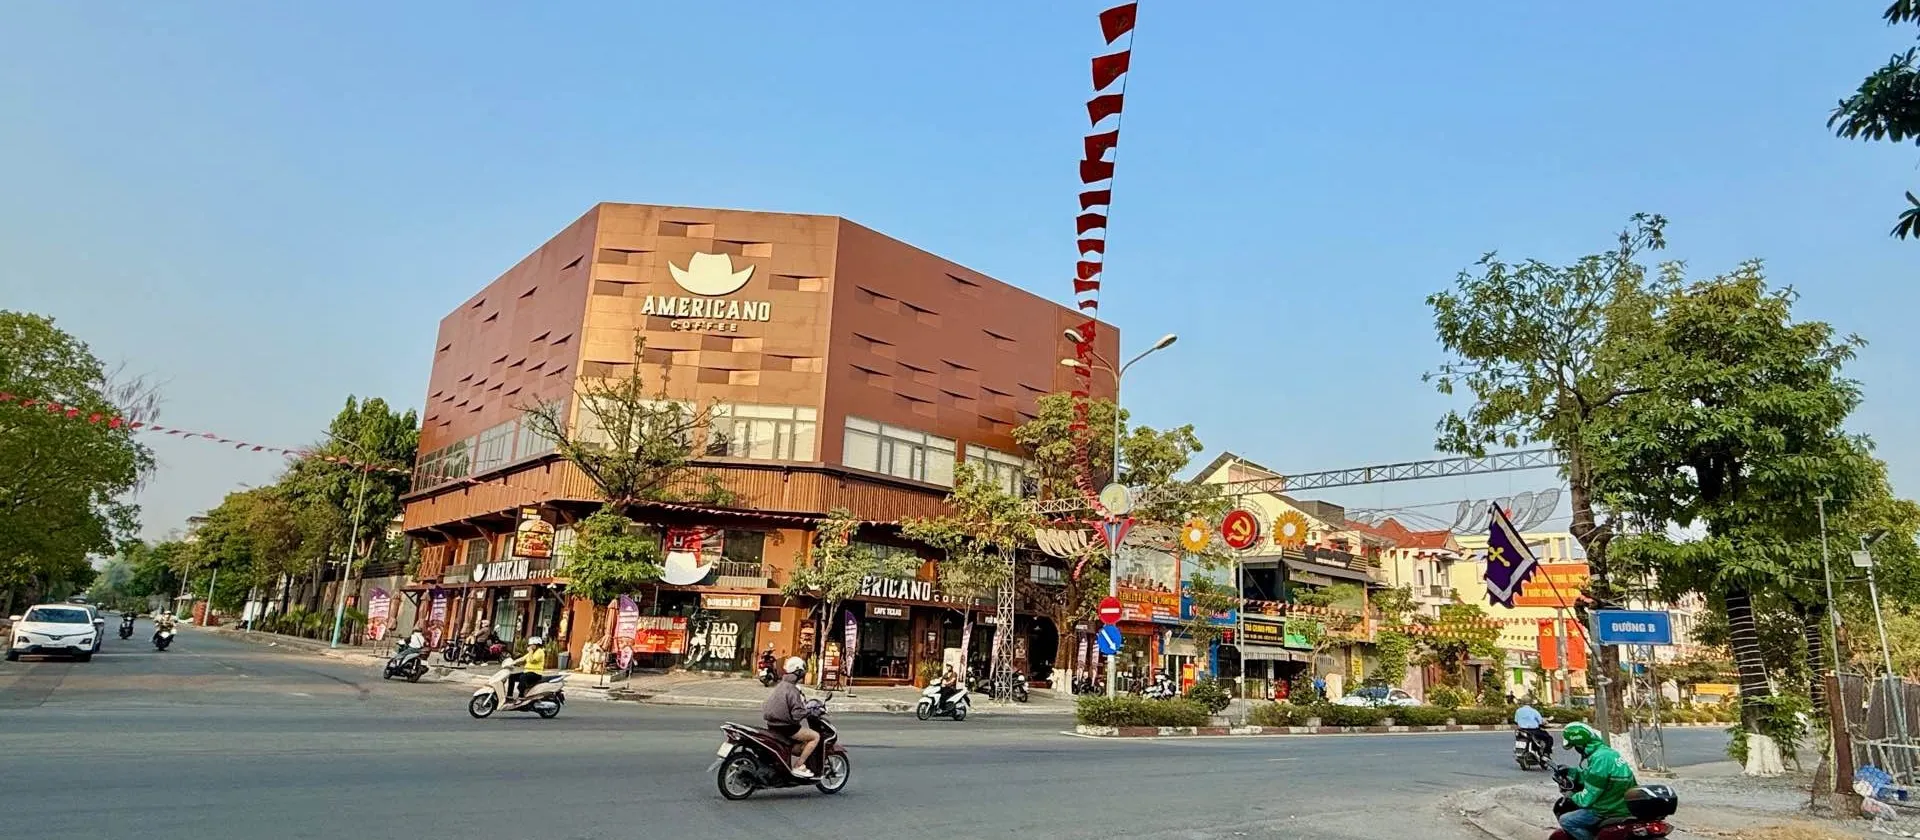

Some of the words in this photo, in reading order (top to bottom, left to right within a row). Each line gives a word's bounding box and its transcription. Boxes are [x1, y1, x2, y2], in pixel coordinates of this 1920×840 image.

[641, 295, 771, 322] AMERICANO
[670, 320, 738, 332] COFFEE
[485, 560, 529, 581] AMERICANO
[861, 575, 931, 601] ERICANO
[711, 622, 738, 634] BAD
[1611, 621, 1646, 633] ĐƯỜNG
[1648, 623, 1656, 633] B
[710, 634, 737, 647] MIN
[709, 646, 736, 659] TON
